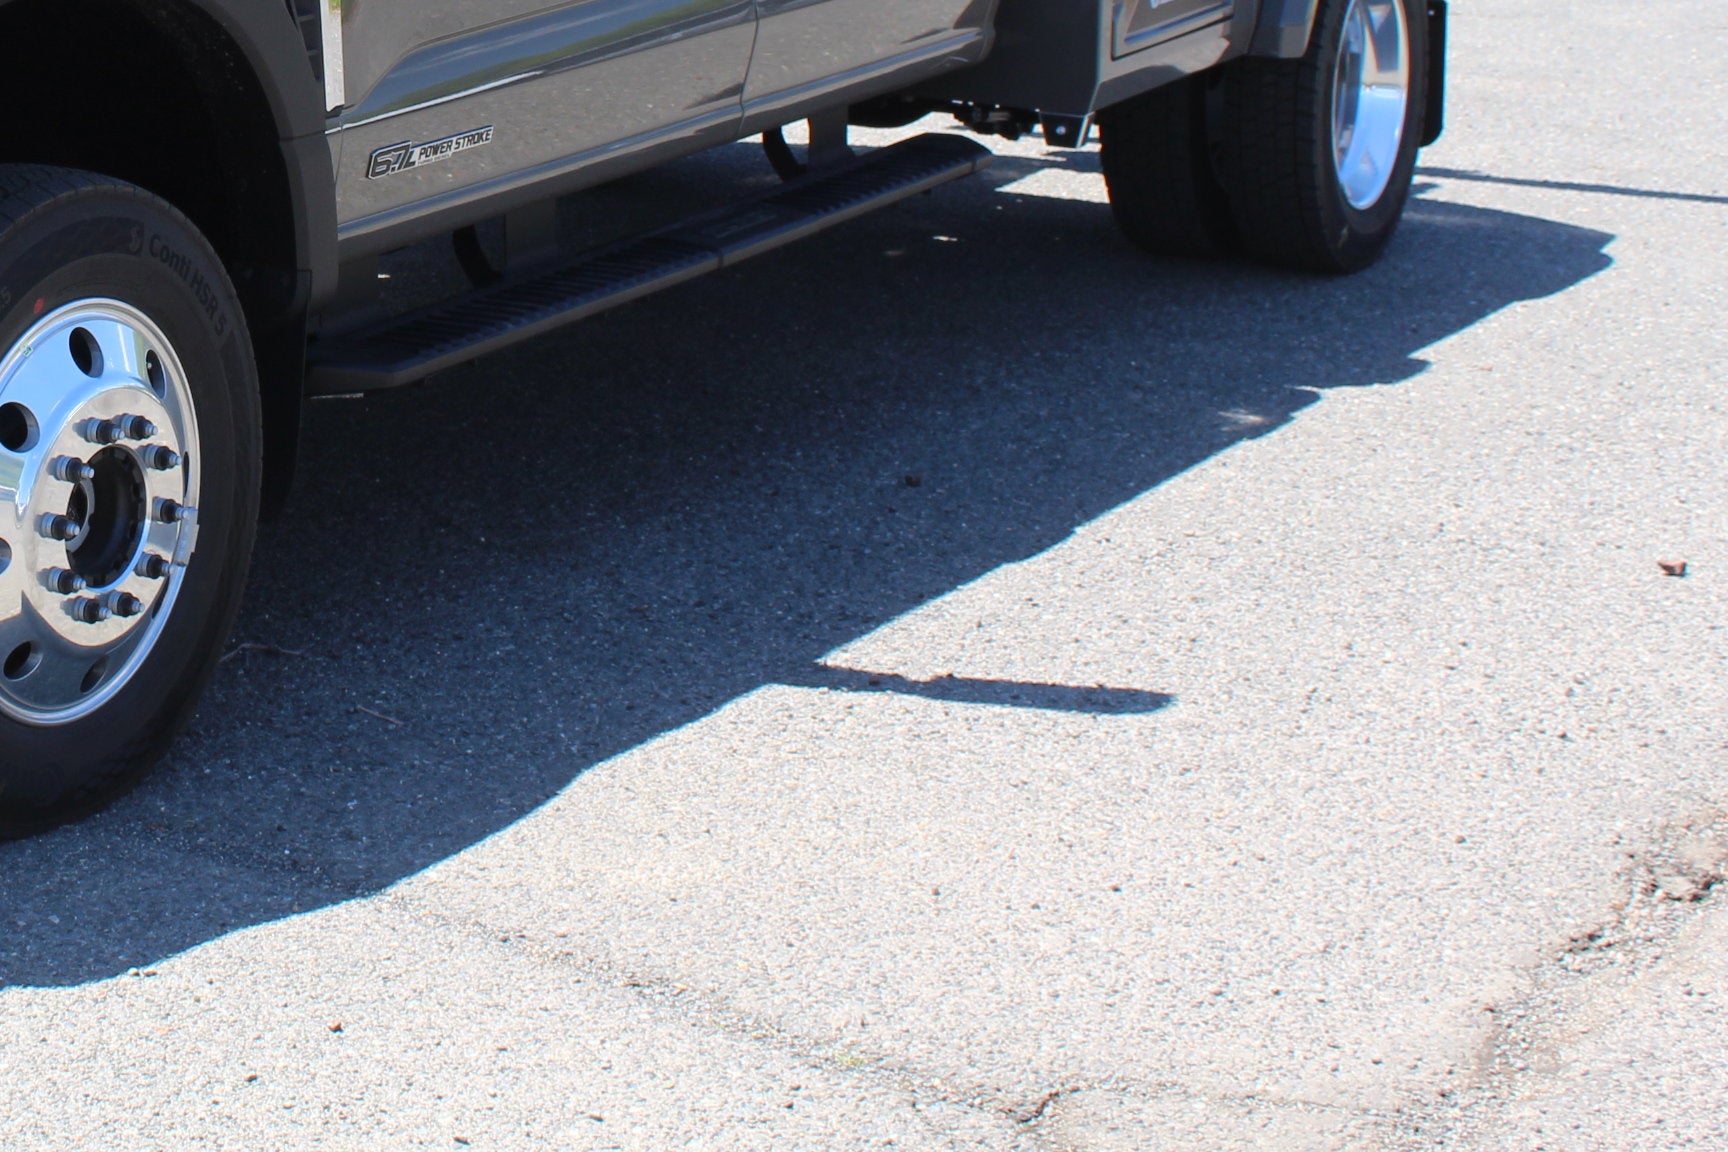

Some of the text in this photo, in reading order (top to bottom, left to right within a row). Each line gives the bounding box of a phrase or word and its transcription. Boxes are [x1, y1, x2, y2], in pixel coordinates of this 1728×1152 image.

[370, 144, 416, 177] 6.7L
[418, 139, 453, 161] POWER
[454, 128, 493, 150] STROKE
